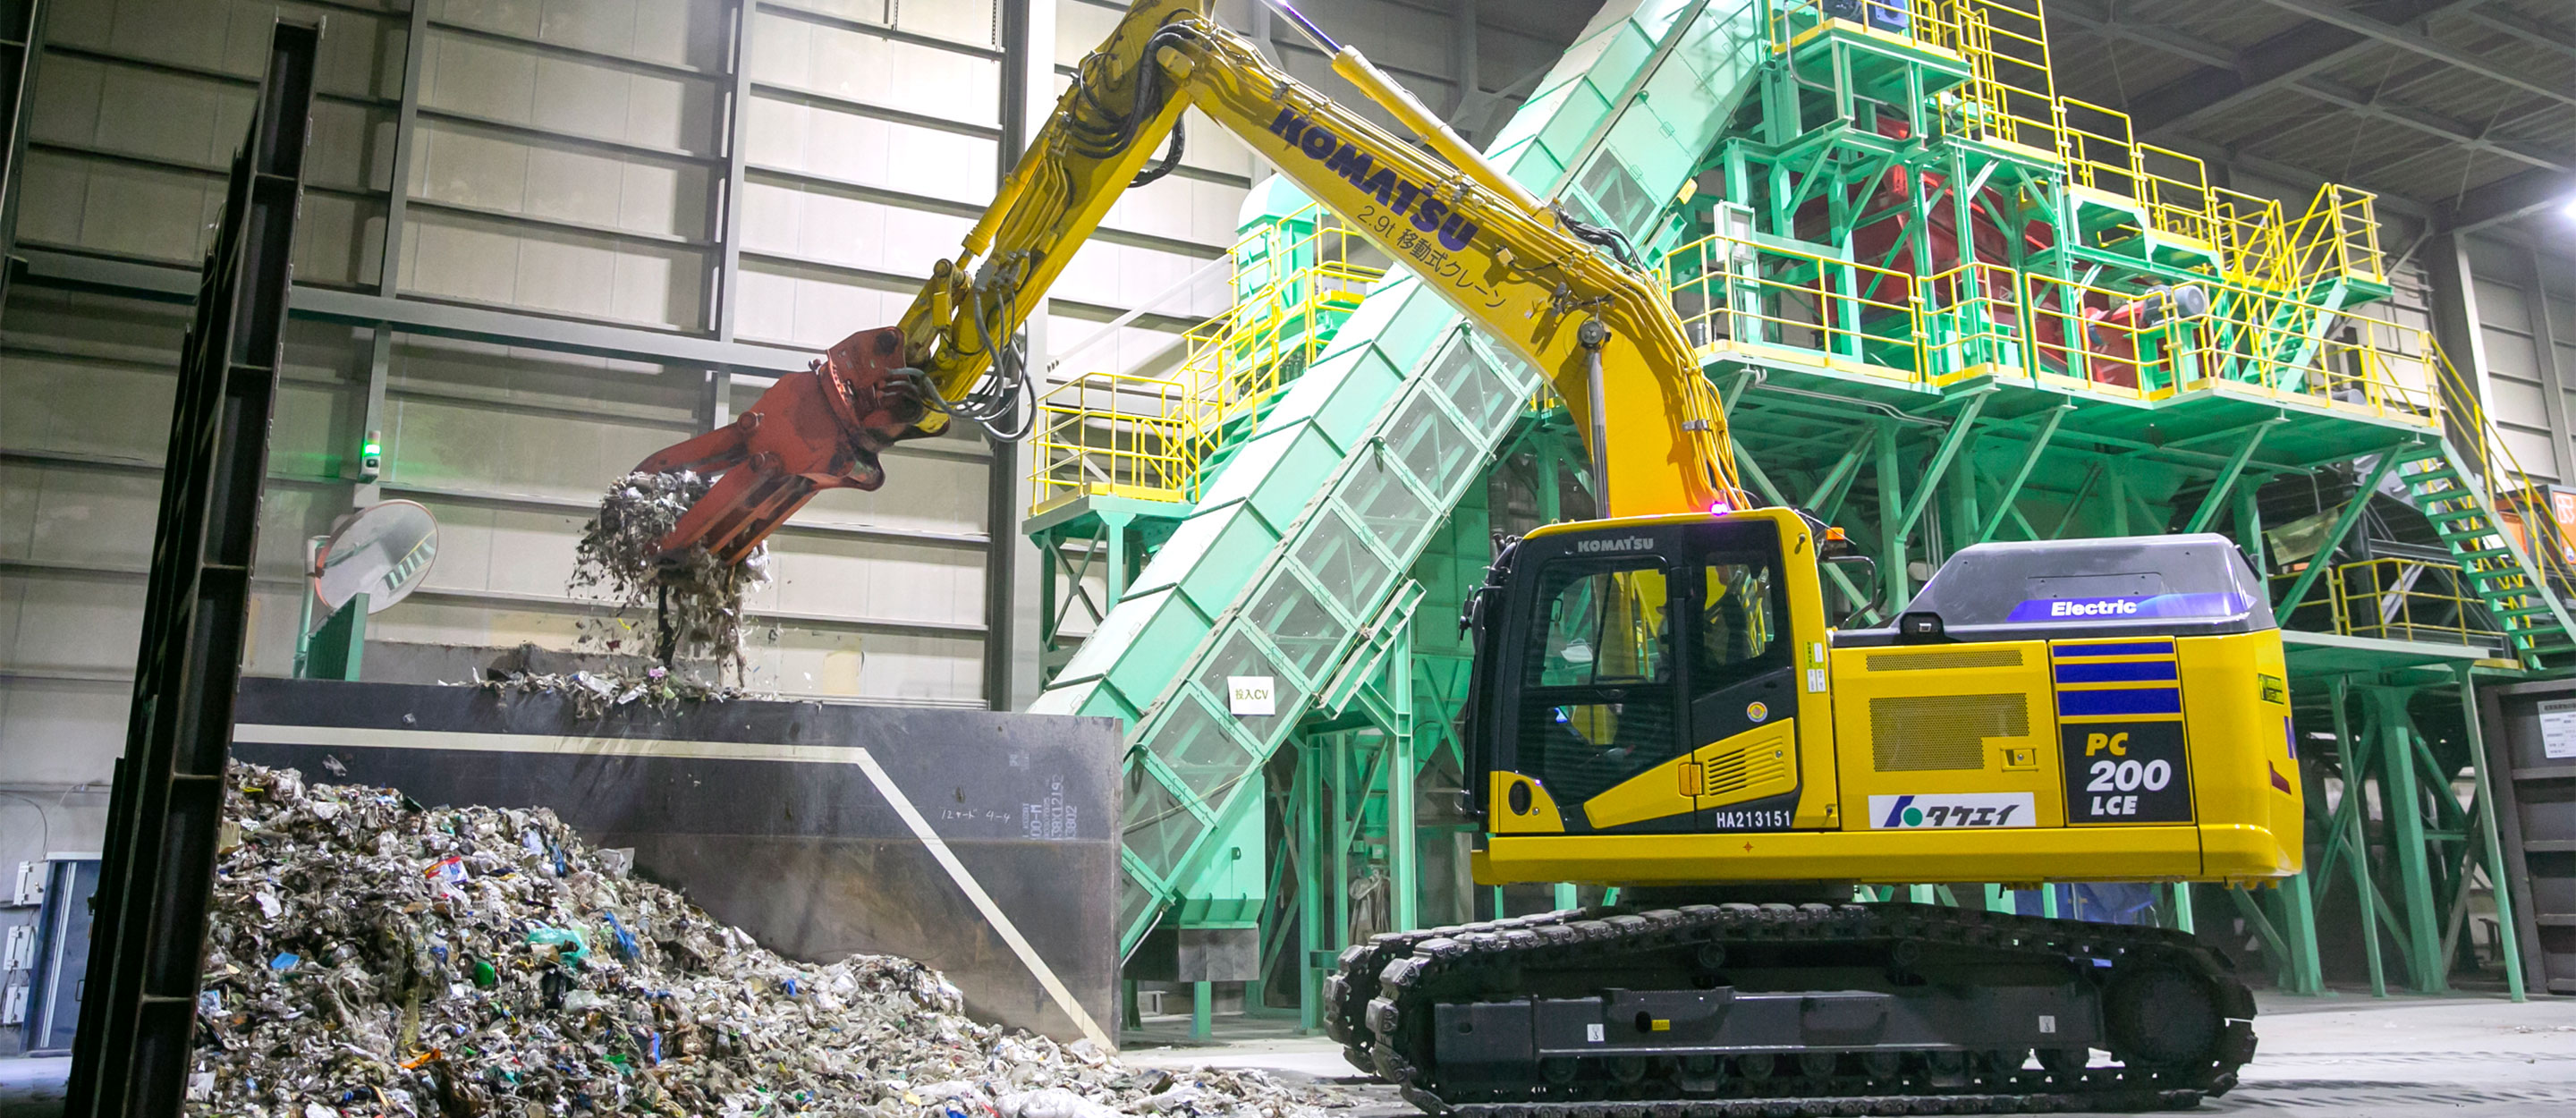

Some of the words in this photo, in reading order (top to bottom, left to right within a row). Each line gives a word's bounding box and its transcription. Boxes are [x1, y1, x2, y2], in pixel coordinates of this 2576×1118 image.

[1269, 108, 1479, 252] KOMATSU
[1357, 205, 1396, 239] 2.9t
[1396, 227, 1507, 308] 移動式クレーン
[1578, 536, 1654, 553] KOMATSU
[2051, 599, 2138, 617] Electric
[1235, 688, 1268, 700] 投入CV
[2085, 732, 2129, 757] PC
[2086, 758, 2172, 792] 200
[1926, 805, 2021, 827] タケエイ
[2090, 795, 2139, 816] LCE
[1716, 810, 1791, 828] HA213151
